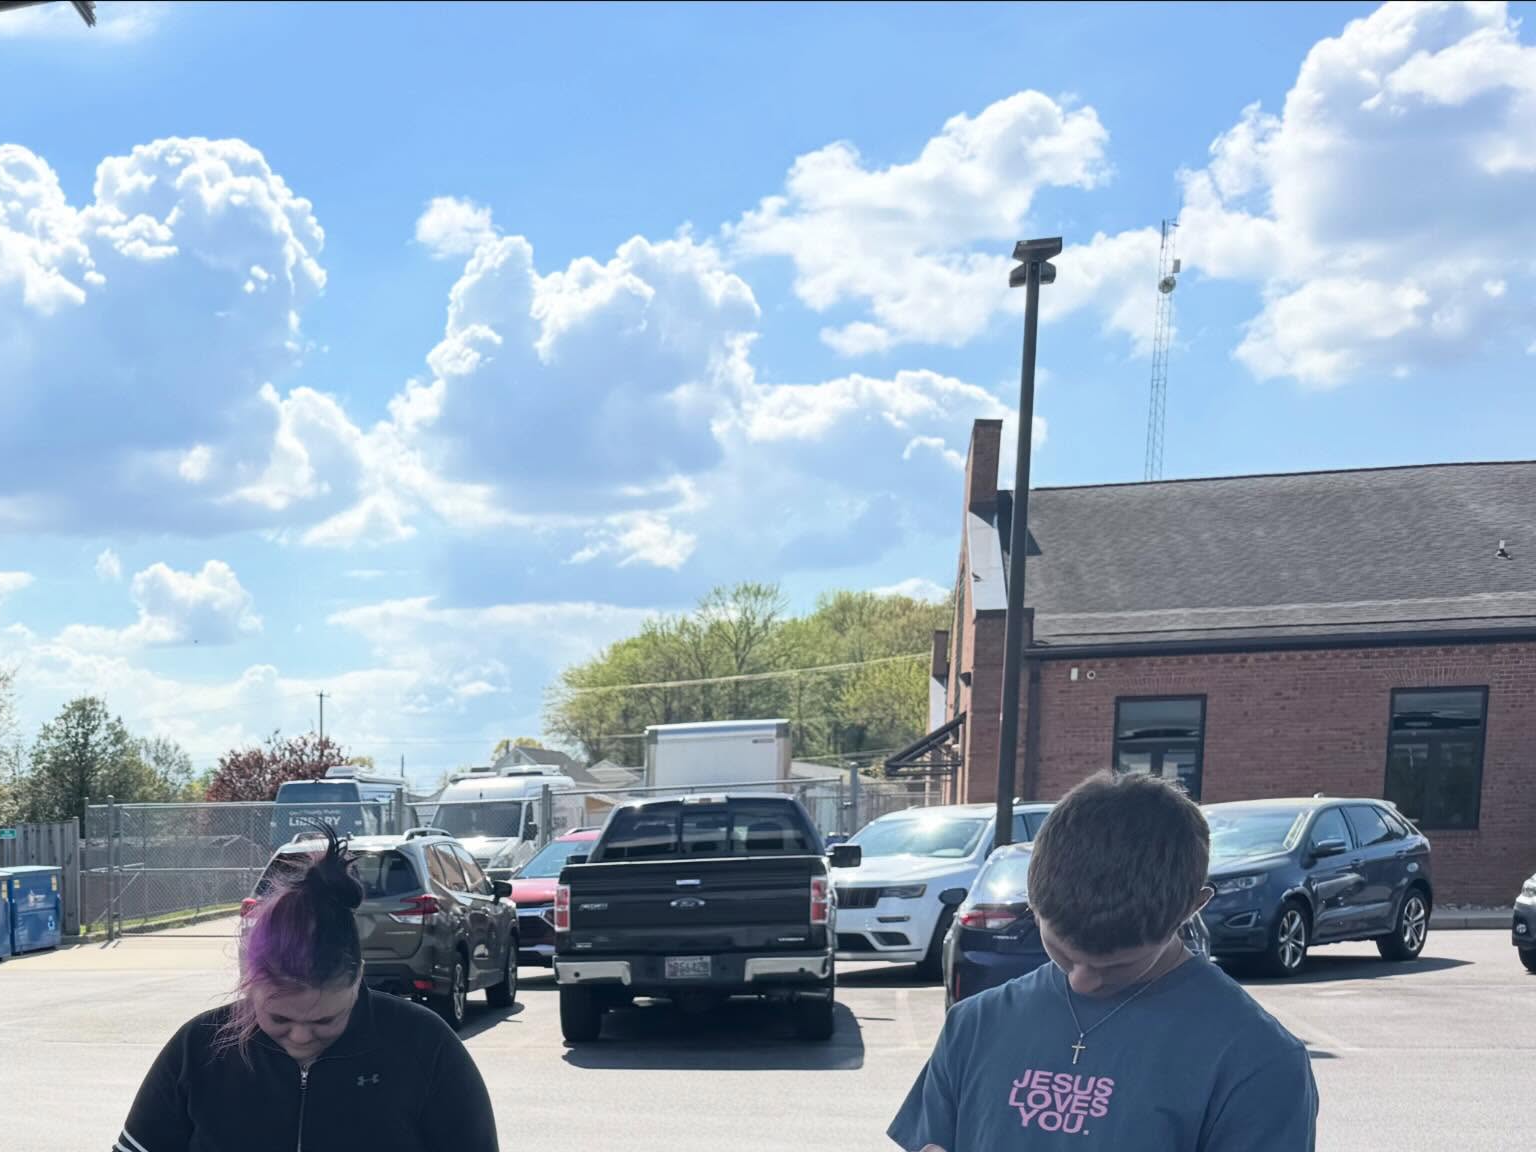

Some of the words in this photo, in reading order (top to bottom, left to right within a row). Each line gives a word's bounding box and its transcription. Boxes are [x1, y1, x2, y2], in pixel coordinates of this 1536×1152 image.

[288, 815, 341, 827] LIBRARY
[1013, 1069, 1115, 1098] JESUS
[1008, 1087, 1110, 1118] LOVES
[1018, 1106, 1089, 1136] YOU.
